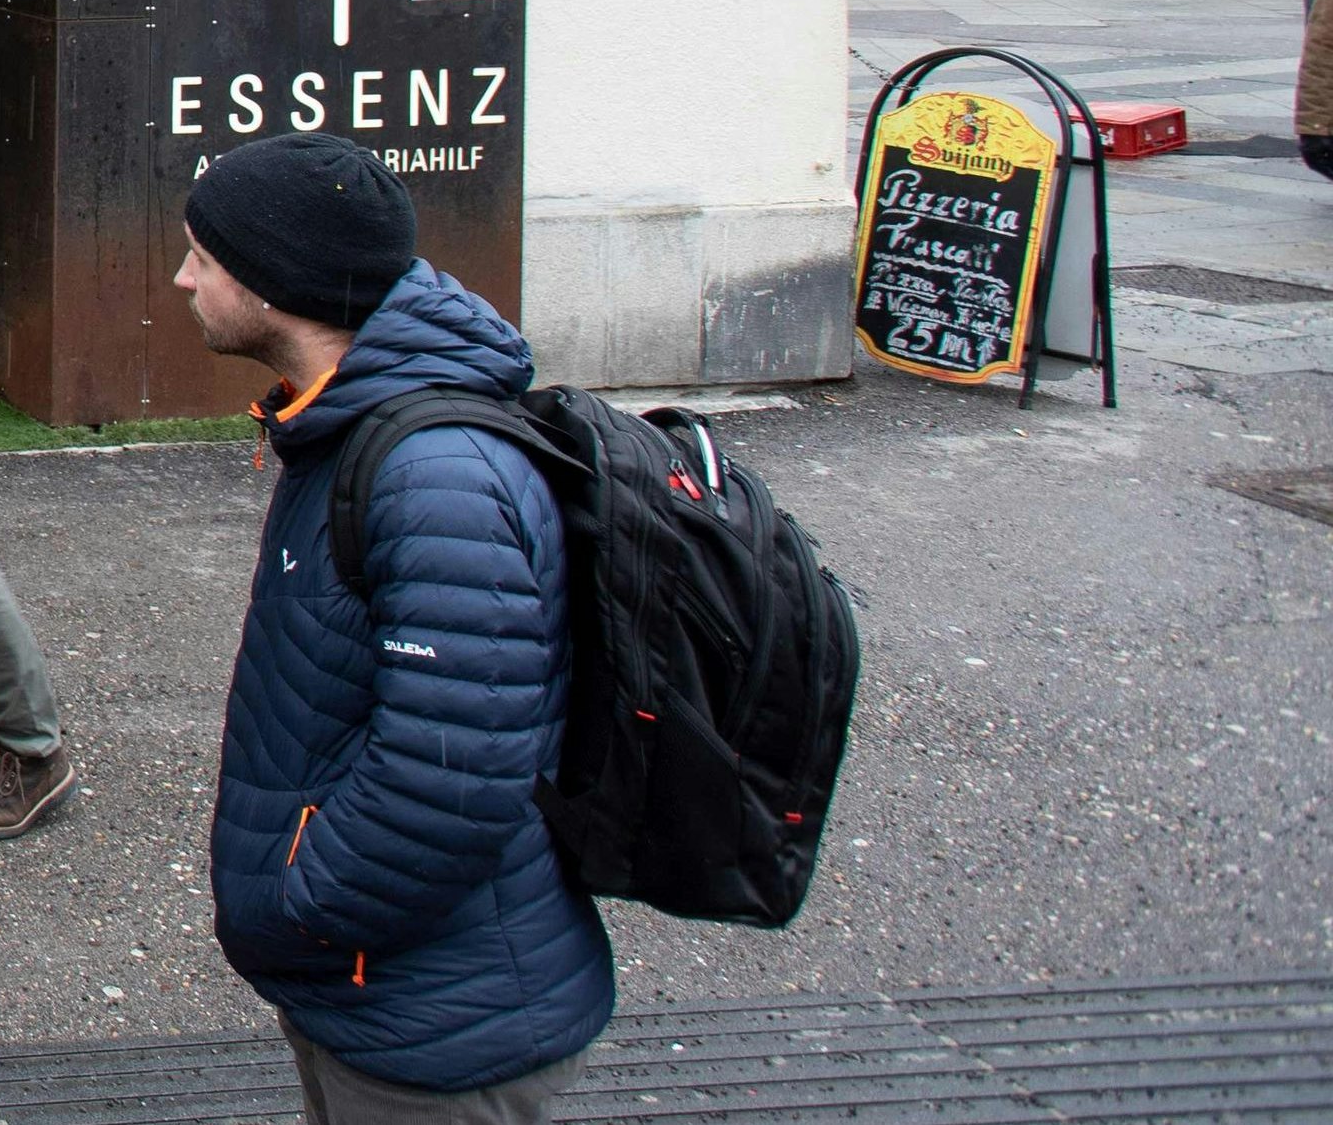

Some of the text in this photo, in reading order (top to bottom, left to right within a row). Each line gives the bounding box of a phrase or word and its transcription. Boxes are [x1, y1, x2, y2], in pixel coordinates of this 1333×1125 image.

[171, 66, 507, 135] ESSENZ
[910, 136, 1014, 176] Svijany
[878, 169, 1020, 230] Pizzeria
[877, 216, 1002, 271] Frascati
[383, 640, 437, 658] SALEWA
